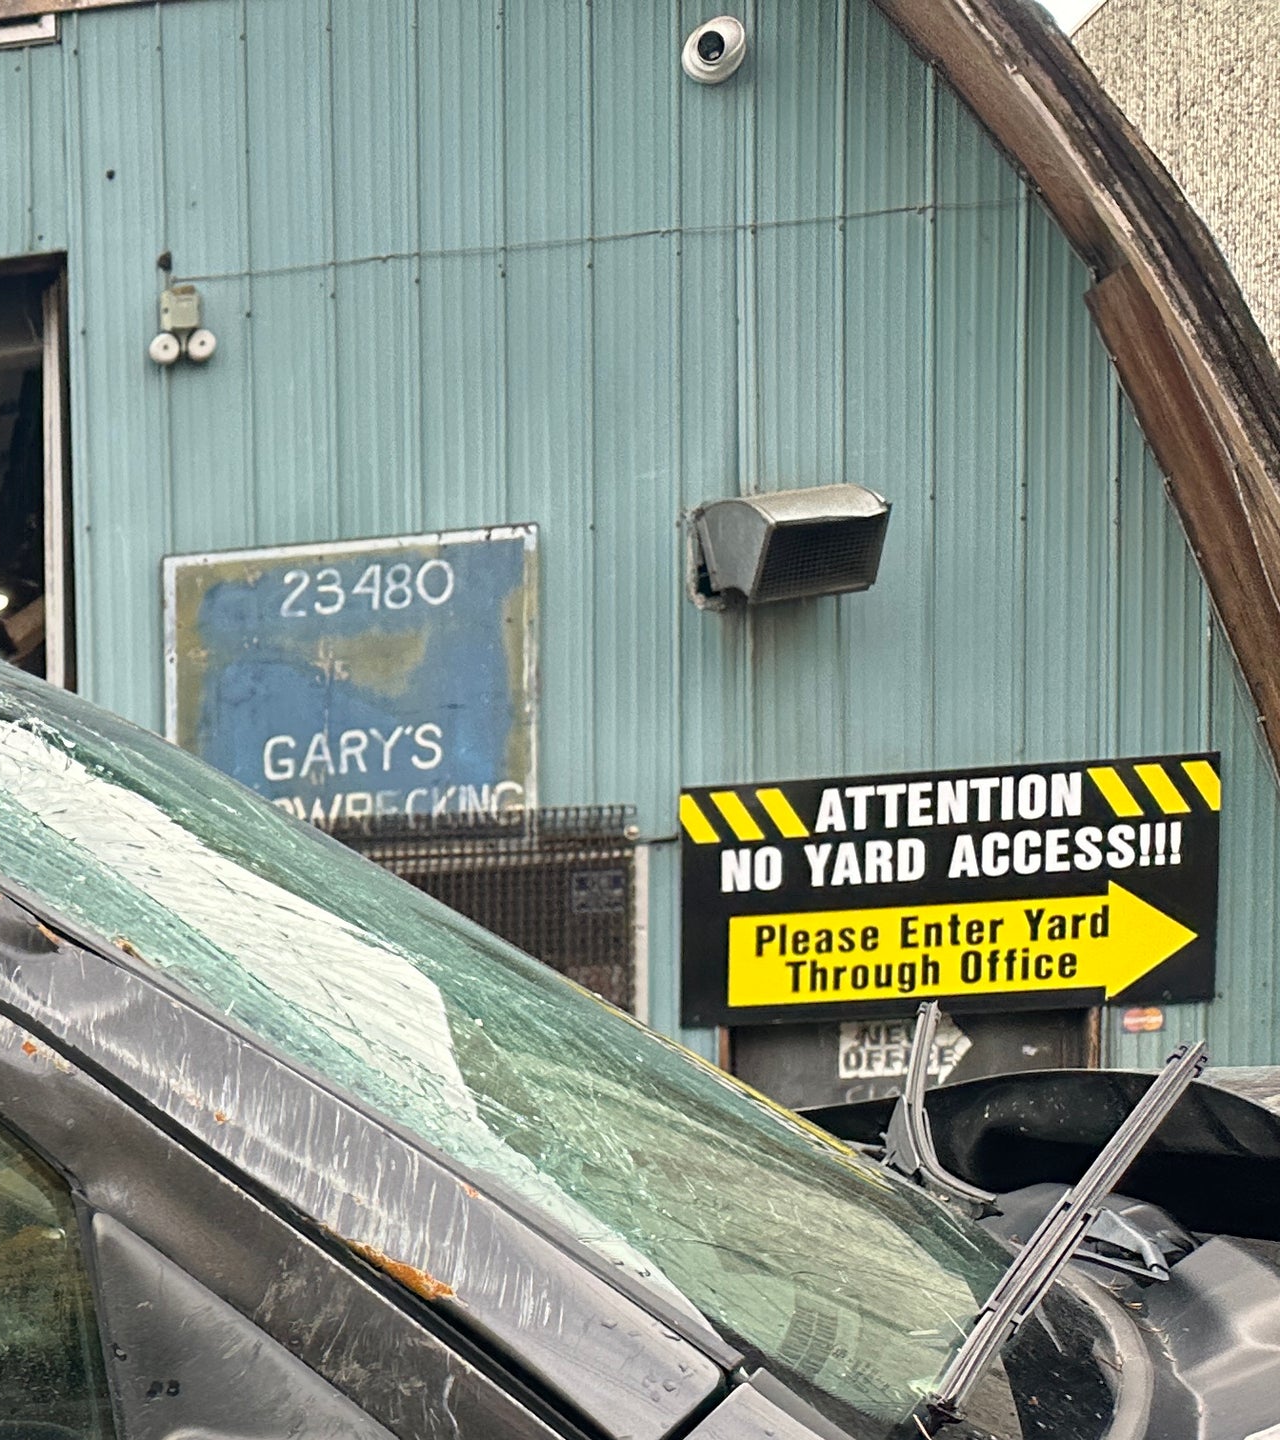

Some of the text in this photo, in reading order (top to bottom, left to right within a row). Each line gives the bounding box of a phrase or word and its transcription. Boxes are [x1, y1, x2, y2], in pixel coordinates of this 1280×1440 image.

[281, 558, 454, 618] 23480
[263, 722, 443, 781] GARY'S
[814, 772, 1082, 834] ATTENTION
[721, 821, 1183, 893] NO YARD ACCESS!!!
[755, 904, 1110, 957] Please Enter Yard
[786, 947, 1078, 993] Through Office
[858, 1022, 916, 1046] NE
